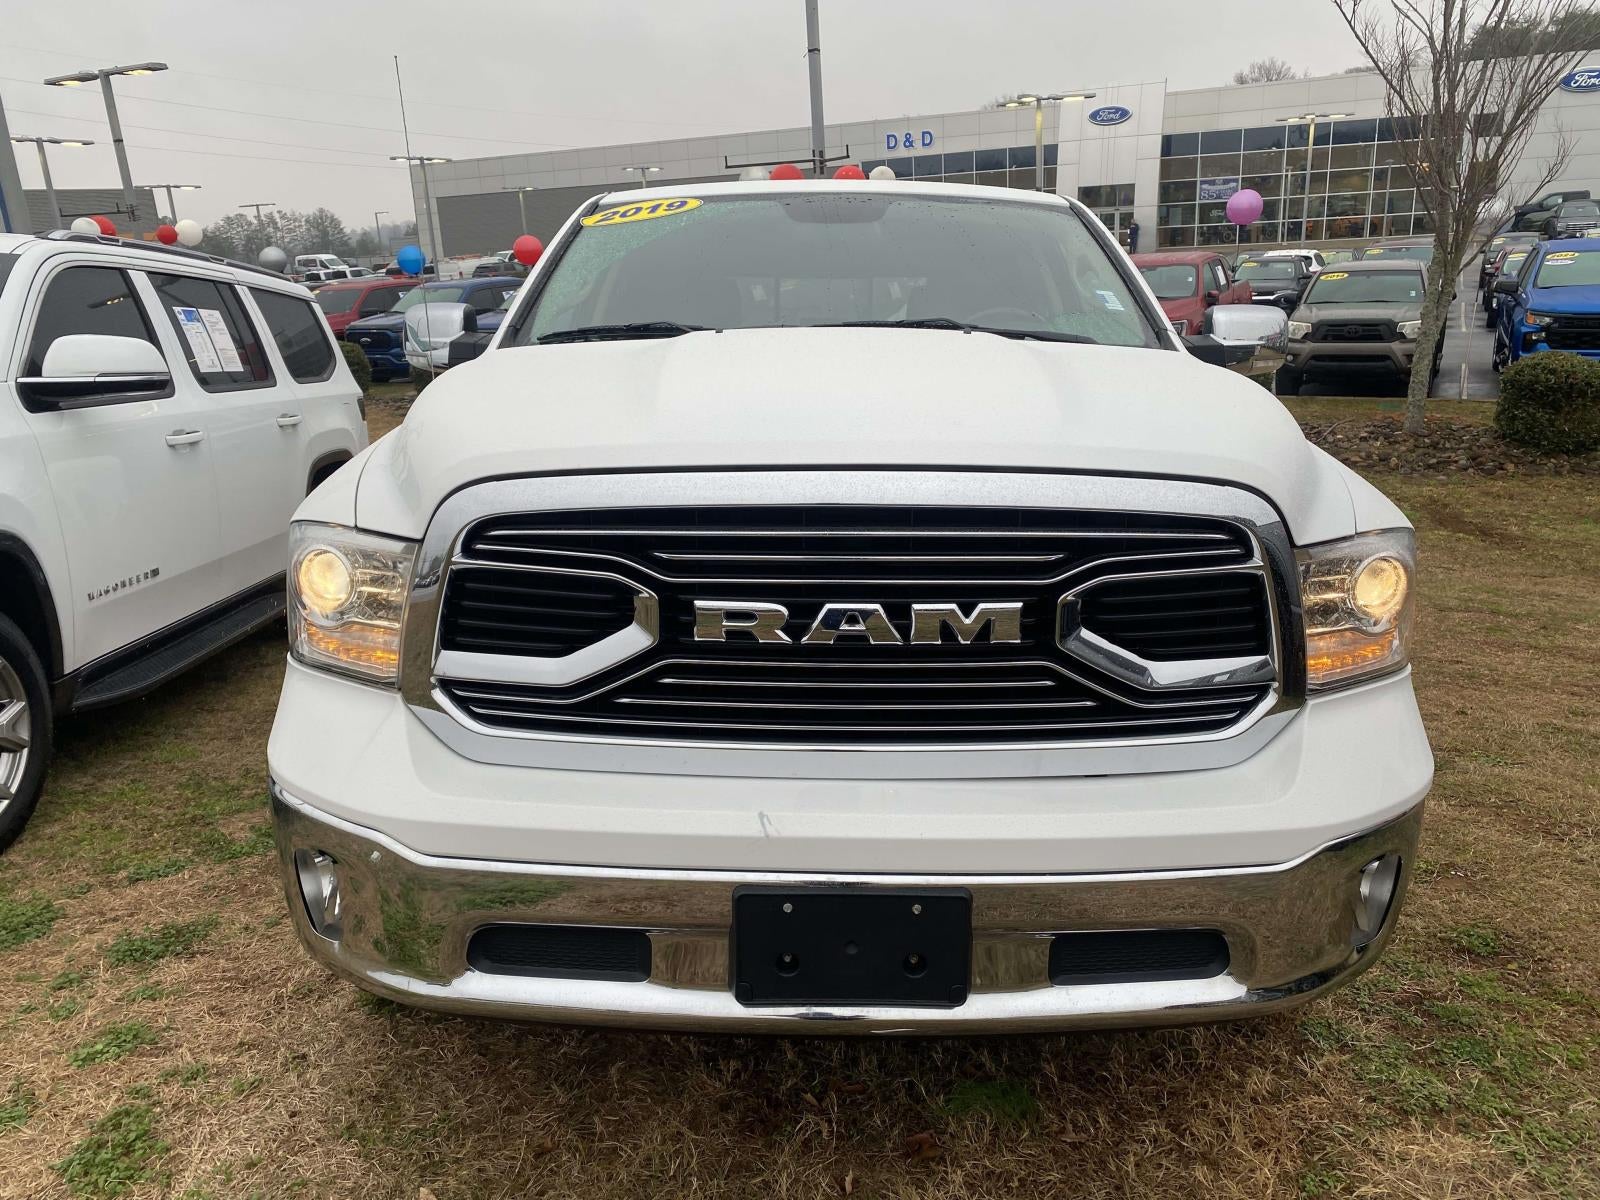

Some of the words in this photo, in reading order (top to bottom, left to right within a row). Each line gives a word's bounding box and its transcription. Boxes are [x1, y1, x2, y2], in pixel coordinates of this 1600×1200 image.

[1096, 109, 1122, 121] Ford
[886, 134, 898, 150] D
[903, 132, 914, 148] &
[922, 130, 934, 147] D
[1200, 190, 1217, 200] 85
[592, 200, 689, 224] 2019
[87, 571, 150, 602] WAGONEER
[693, 600, 1024, 645] RAM
